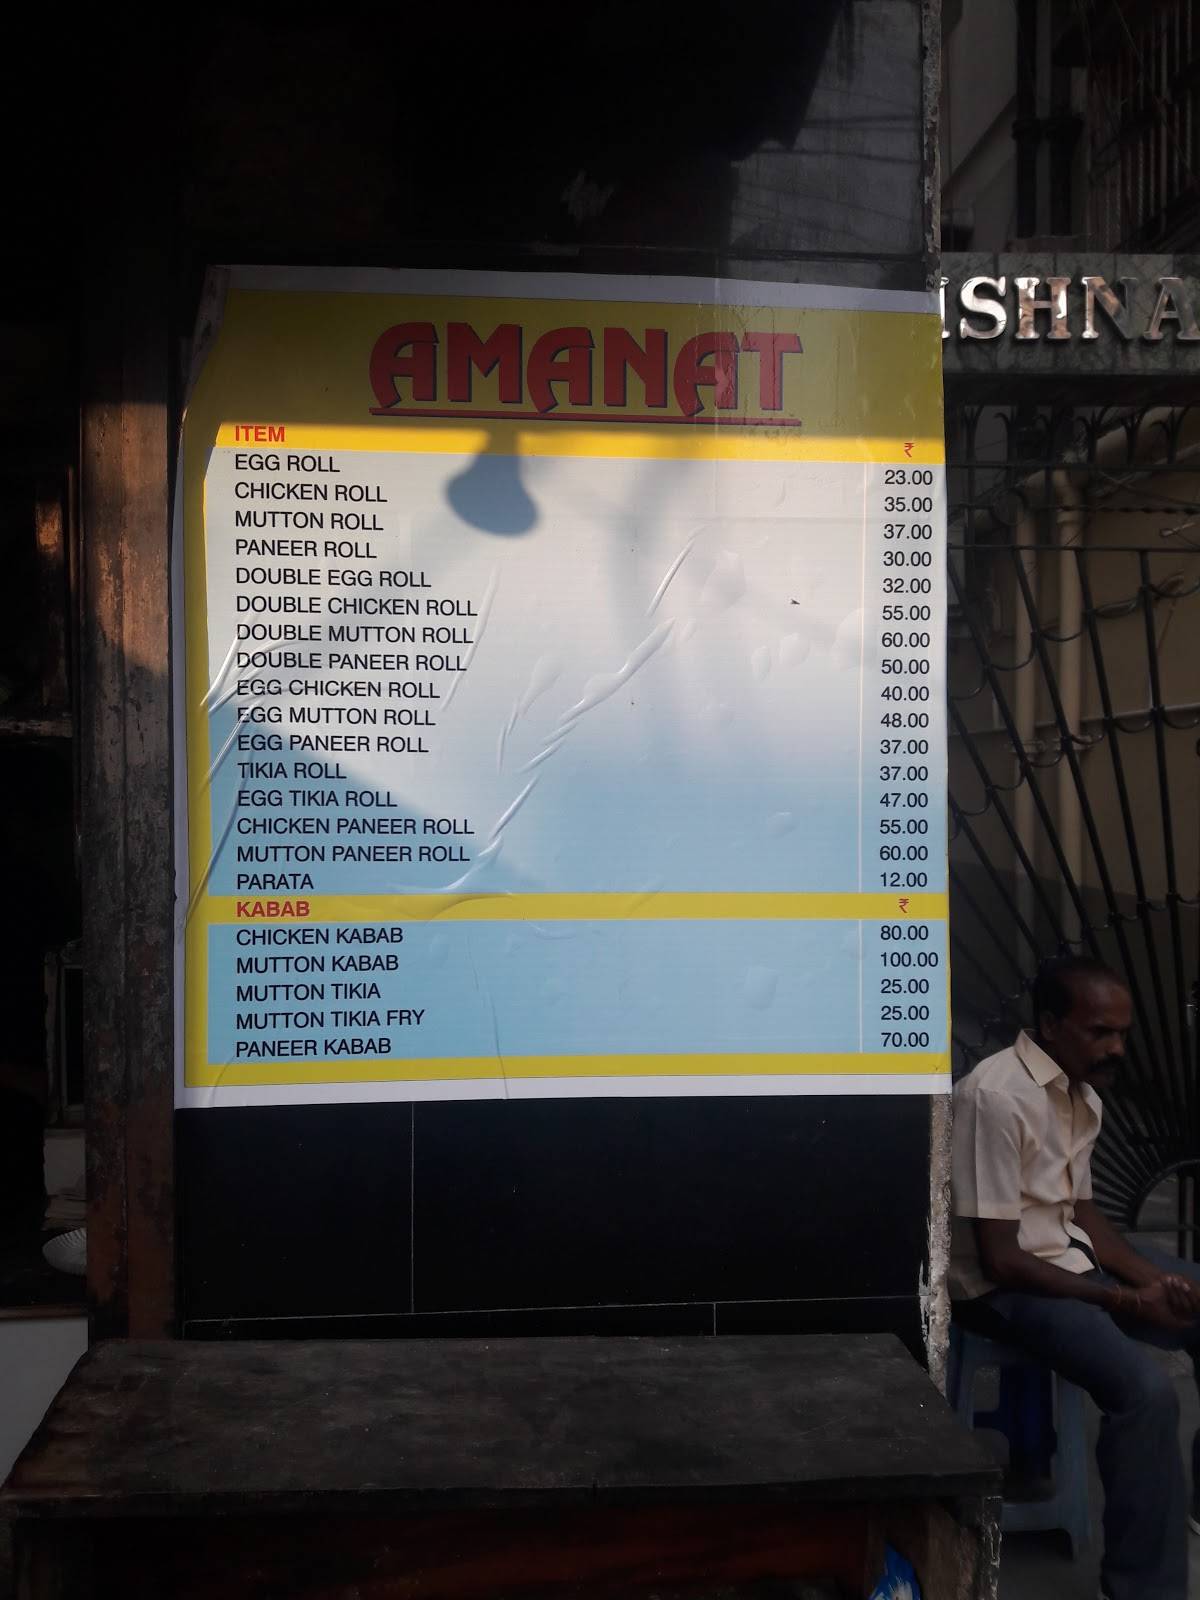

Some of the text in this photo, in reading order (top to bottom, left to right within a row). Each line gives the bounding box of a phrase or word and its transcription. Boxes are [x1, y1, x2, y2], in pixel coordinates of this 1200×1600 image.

[369, 322, 803, 417] AMANAT
[235, 425, 286, 443] ITEM
[236, 454, 340, 472] EGG ROLL
[885, 470, 932, 485] 23.00
[235, 482, 387, 502] CHICKEN ROLL
[885, 497, 932, 512] 35.00
[236, 511, 384, 530] MUTTON ROLL
[884, 524, 932, 539] 37.00
[236, 539, 377, 558] PANEER ROLL
[883, 551, 931, 567] 30.00
[237, 568, 431, 587] DOUBLE EGG ROLL
[883, 578, 931, 593] 32.00
[237, 596, 478, 616] DOUBLE CHICKEN ROLL
[883, 605, 930, 620] 55.00
[237, 624, 473, 643] DOUBLE MUTTON ROLL
[882, 632, 930, 647] 60.00
[237, 651, 467, 671] DOUBLE PANEER ROLL
[882, 659, 929, 674] 50.00
[237, 679, 440, 698] EGG CHICKEN ROLL
[881, 686, 929, 701] 40.00
[238, 707, 436, 725] EGG MUTTON ROLL
[881, 713, 929, 728] 48.00
[238, 735, 429, 752] EGG PANEER ROLL
[880, 740, 928, 754] 37.00
[237, 762, 347, 779] TIKIA ROLL
[880, 766, 928, 781] 37.00
[236, 790, 398, 807] EGG TIKIA ROLL
[880, 793, 928, 807] 47.00
[237, 818, 474, 834] CHICKEN PANEER ROLL
[880, 819, 928, 834] 55.00
[238, 846, 470, 862] MUTTON PANEER ROLL
[880, 846, 928, 860] 60.00
[237, 874, 314, 890] PARATA
[881, 872, 927, 887] 12.00
[237, 901, 309, 917] KABAB
[237, 928, 403, 945] CHICKEN KABAB
[881, 925, 928, 940] 80.00
[237, 955, 398, 973] MUTTON KABAB
[881, 952, 938, 967] 100.00
[237, 983, 381, 1001] MUTTON TIKIA
[881, 979, 929, 994] 25.00
[237, 1009, 424, 1029] MUTTON TIKIA FRY
[881, 1006, 929, 1020] 25.00
[237, 1038, 391, 1057] PANEER KABAB
[881, 1032, 929, 1047] 70.00
